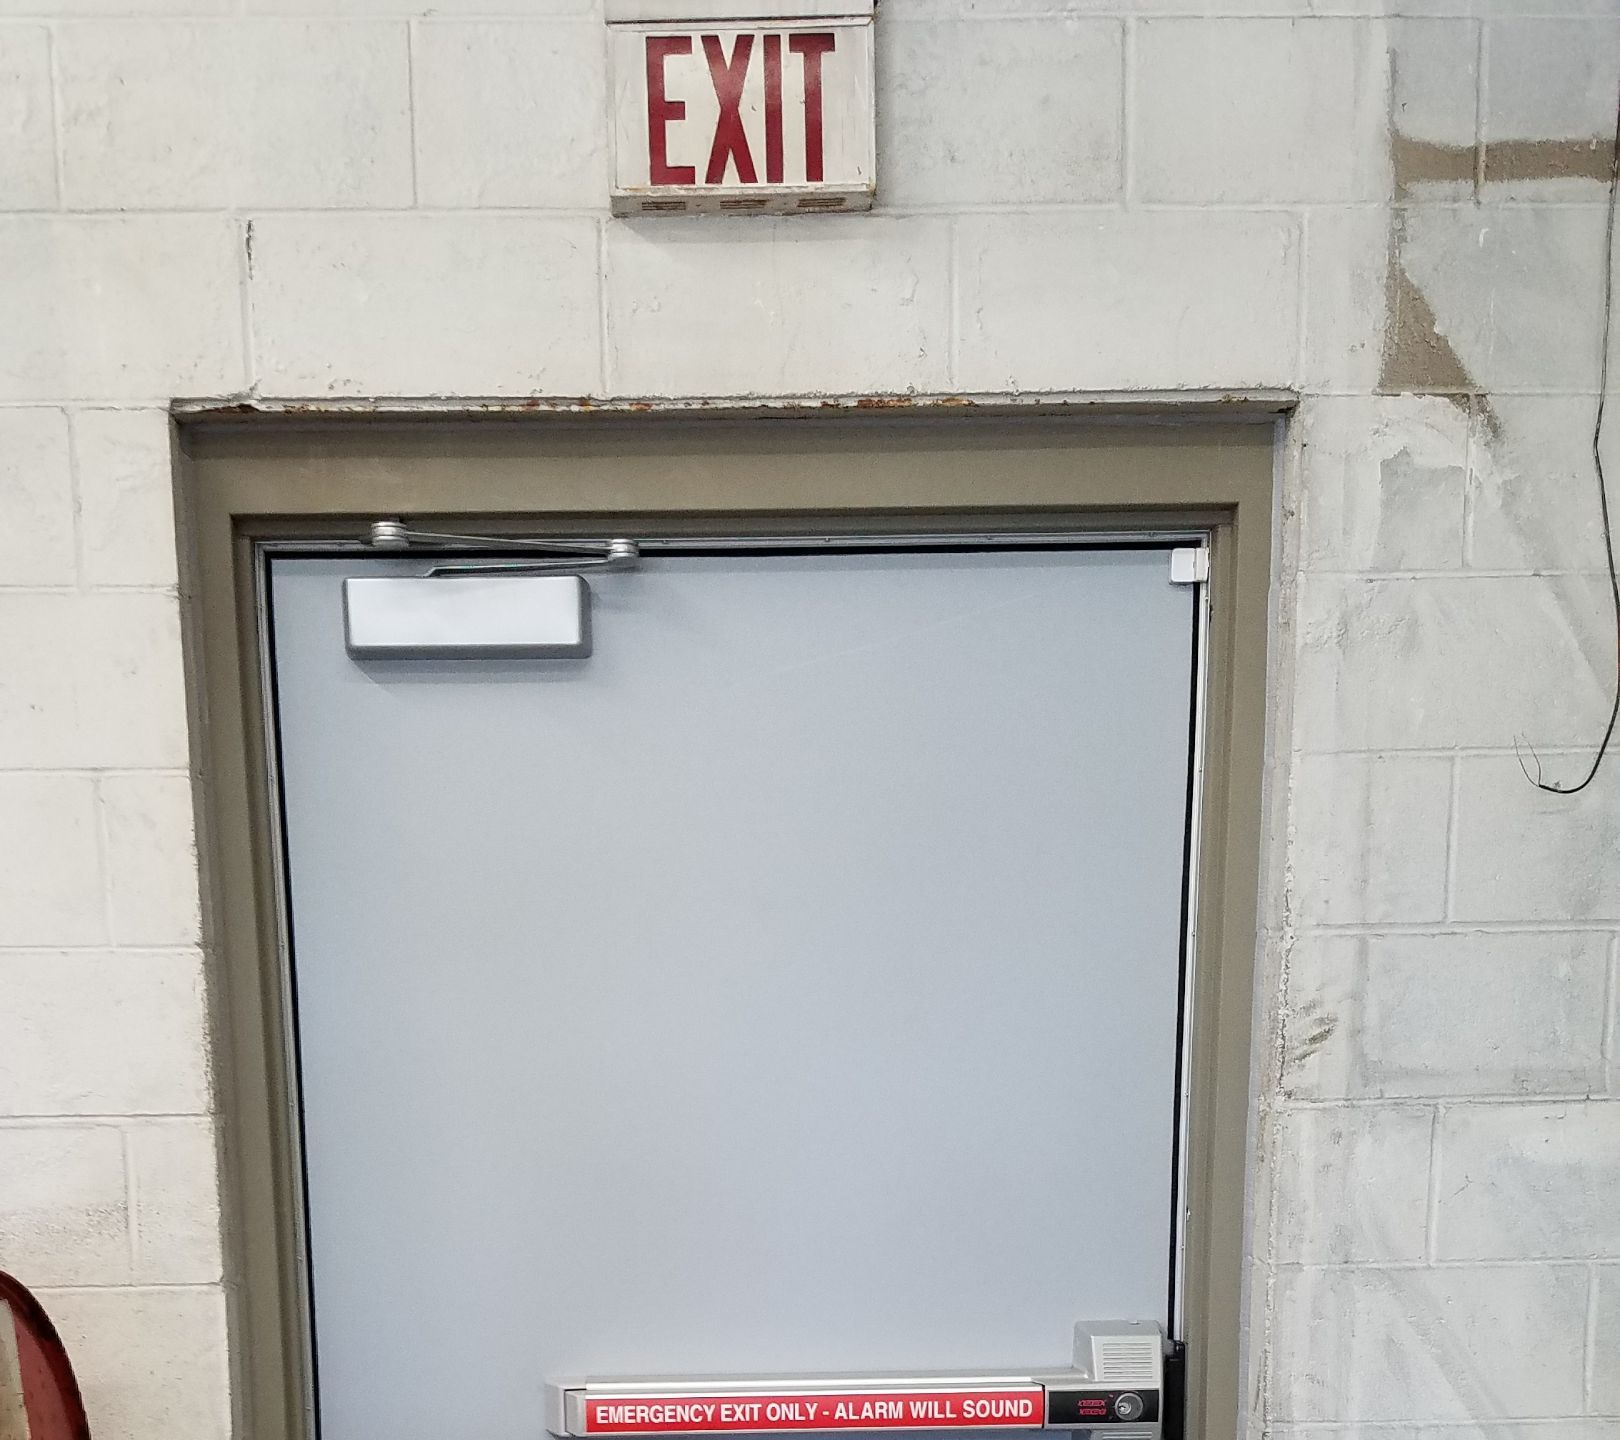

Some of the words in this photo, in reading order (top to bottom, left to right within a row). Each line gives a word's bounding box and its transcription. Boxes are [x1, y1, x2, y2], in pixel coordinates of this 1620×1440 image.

[645, 33, 835, 186] EXIT
[595, 1404, 716, 1424] EMERGENCY
[720, 1403, 762, 1422] EXIT
[766, 1402, 819, 1422] ONLY
[834, 1401, 904, 1420] ALARM
[909, 1400, 957, 1419] WILL
[962, 1399, 1033, 1418] SOUND
